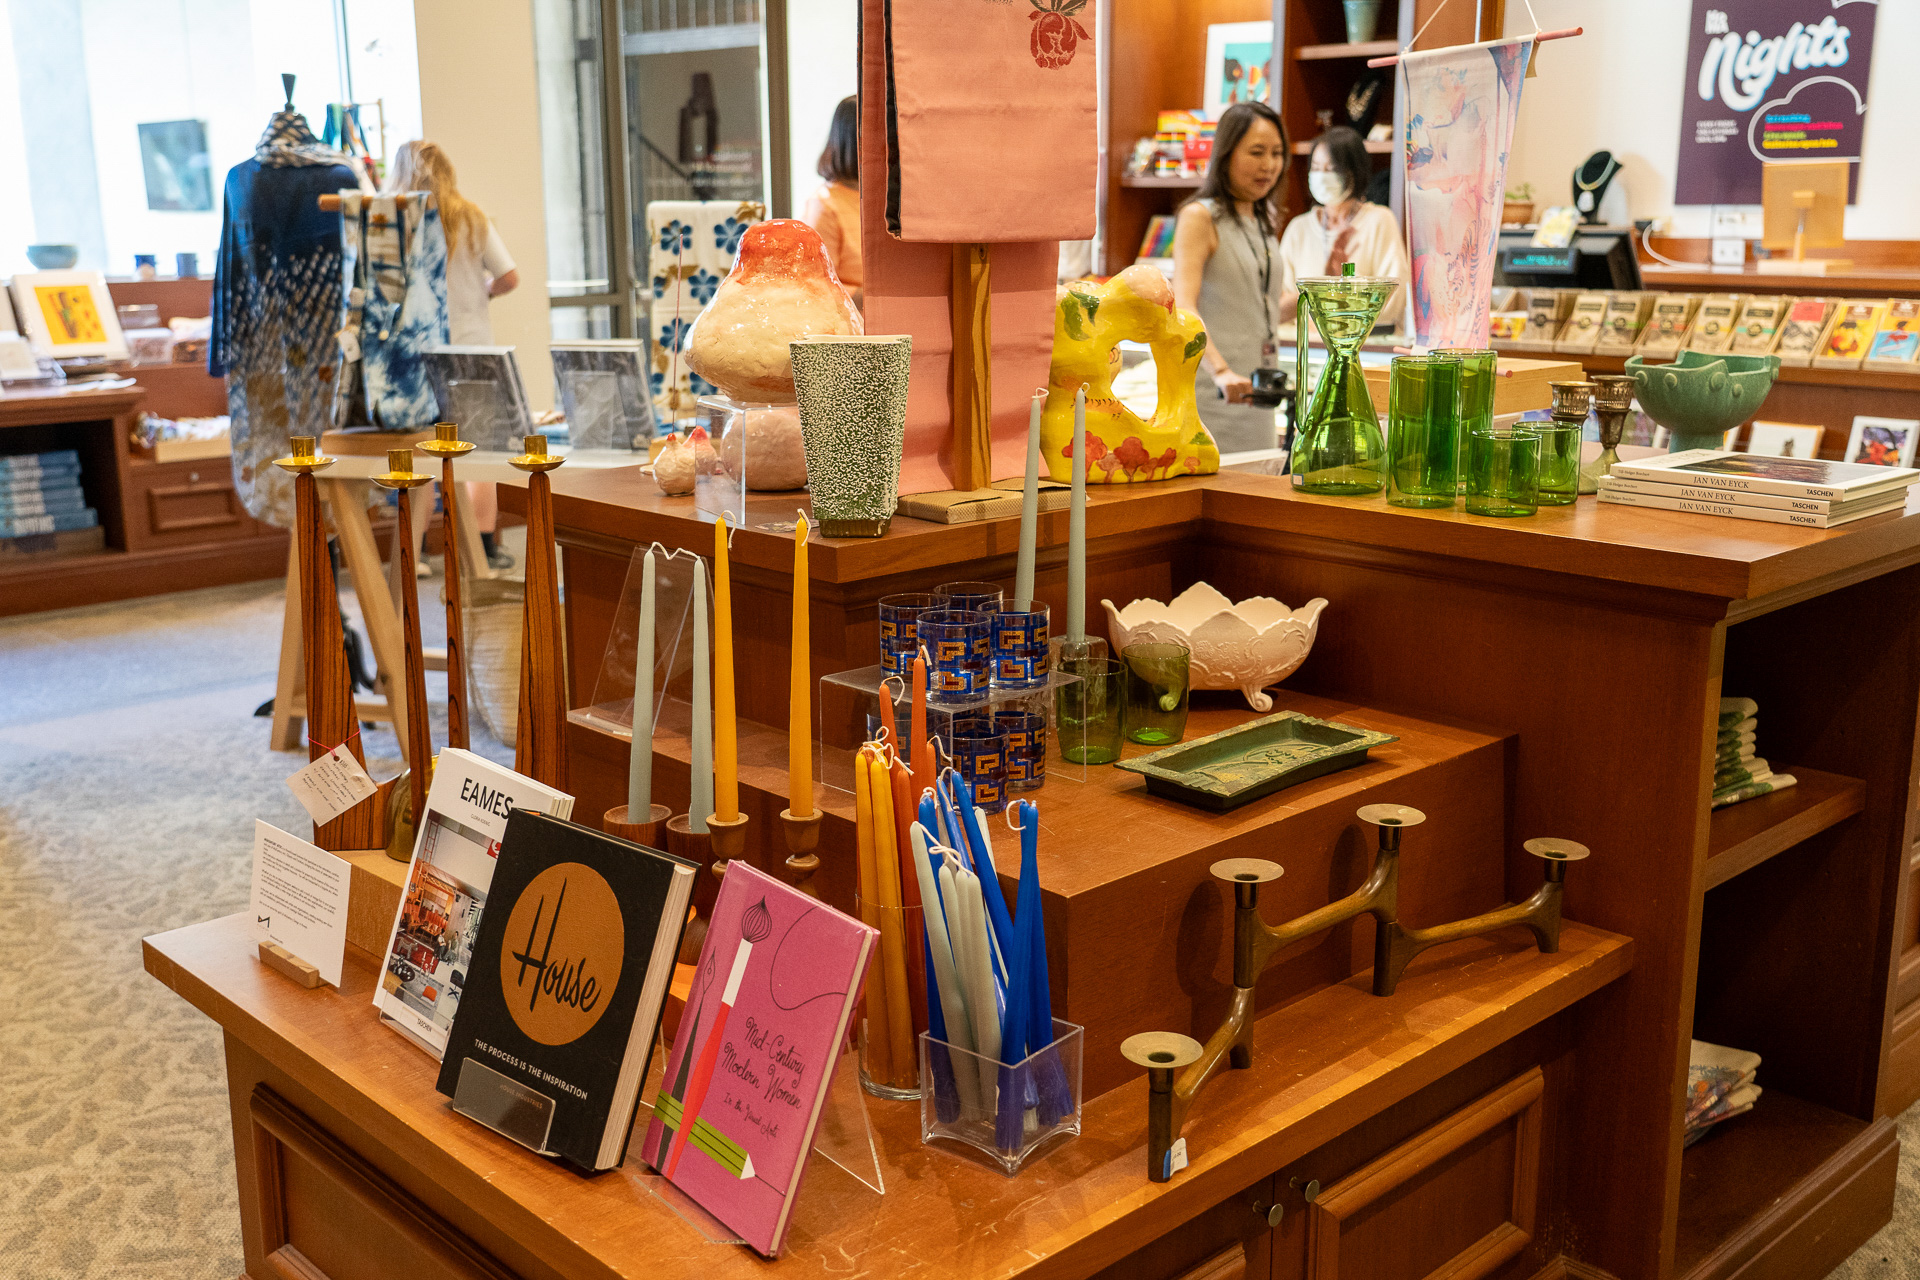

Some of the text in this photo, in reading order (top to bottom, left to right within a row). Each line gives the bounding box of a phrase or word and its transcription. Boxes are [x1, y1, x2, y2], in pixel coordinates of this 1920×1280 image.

[1698, 15, 1851, 112] Nights
[1680, 489, 1736, 502] JAN VAN EYCK
[1693, 476, 1750, 489] JAN VAN EYCK
[1806, 488, 1834, 497] TASCHEN
[1678, 502, 1734, 515] JAN VAN EYCK
[1789, 515, 1816, 524] TASCHEN
[1791, 502, 1819, 511] TASCHEN
[460, 777, 514, 820] EAMES
[511, 876, 602, 1013] House
[474, 1038, 588, 1100] THE PROCESS IS THE INSPIRATION
[744, 1016, 806, 1089] Mid-Century
[721, 1041, 802, 1109] Modern Women
[723, 1092, 733, 1106] In
[760, 1120, 780, 1140] Arts
